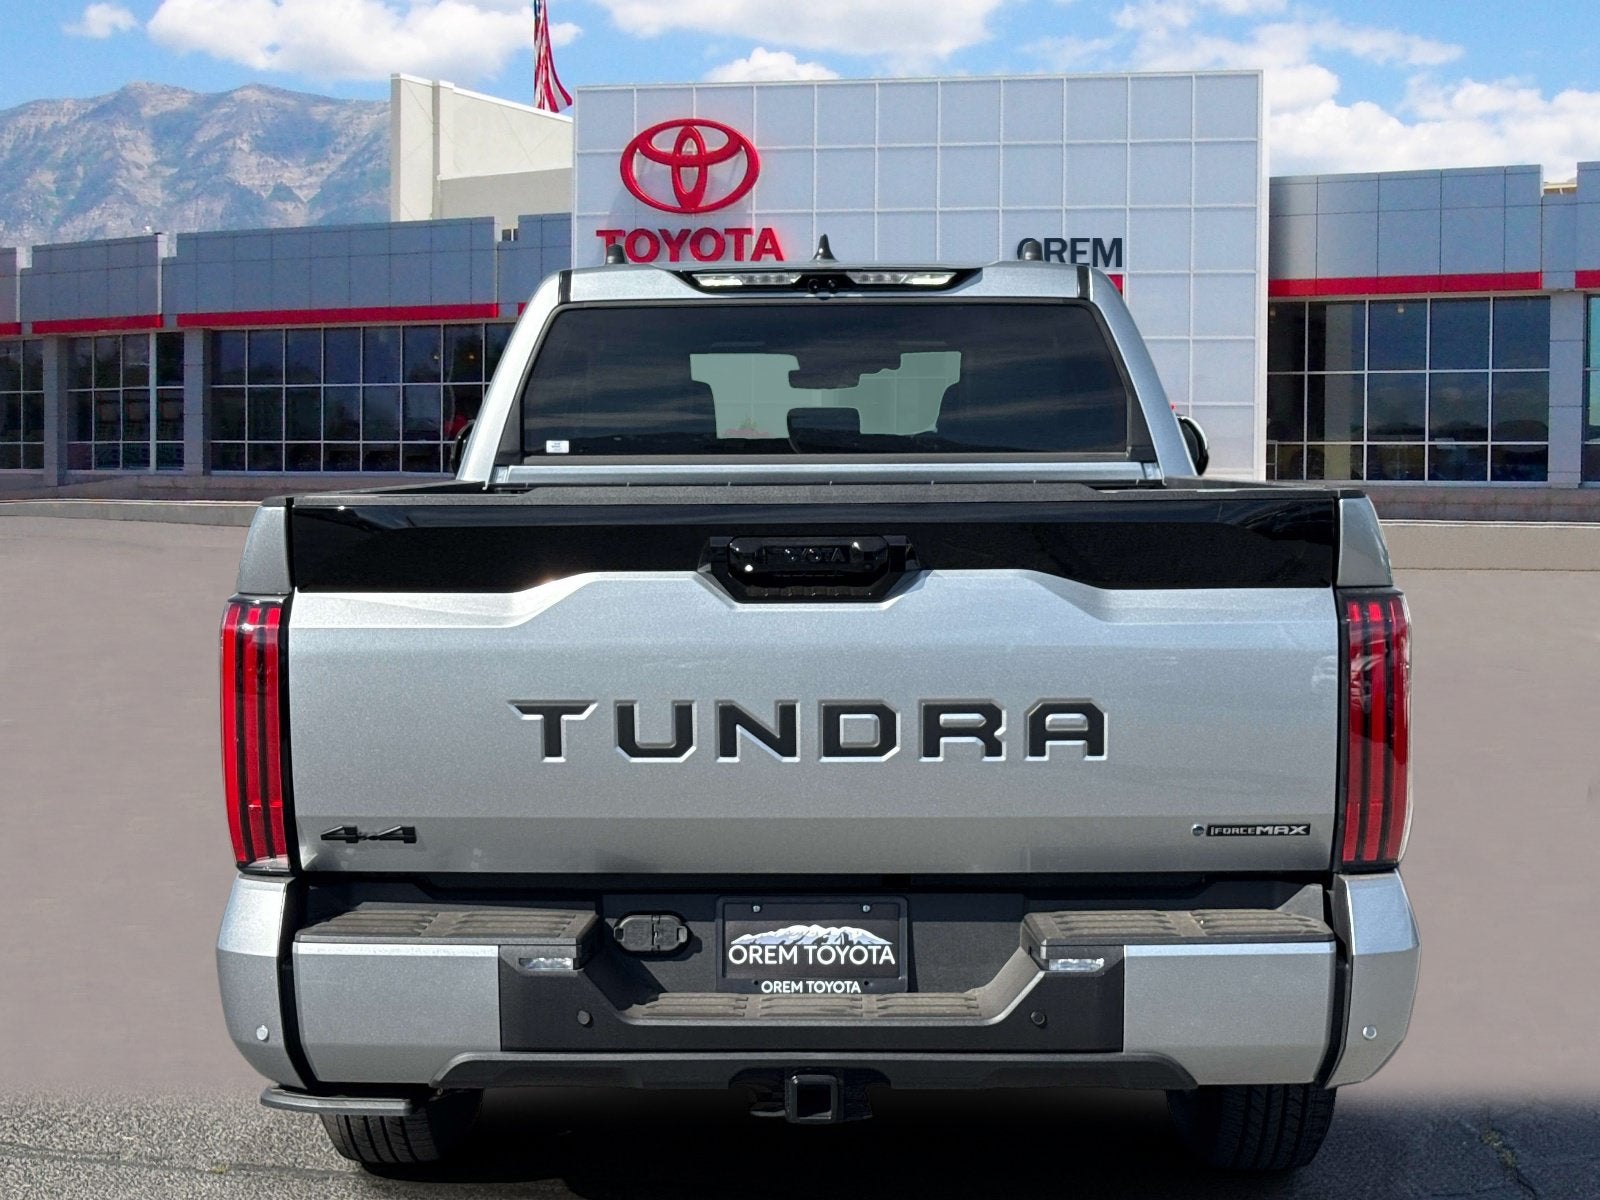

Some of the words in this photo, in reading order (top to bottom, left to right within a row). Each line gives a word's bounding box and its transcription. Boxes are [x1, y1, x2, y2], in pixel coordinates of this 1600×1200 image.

[596, 227, 785, 263] TOYOTA
[507, 698, 1109, 763] TUNDRA
[728, 945, 798, 965] OREM
[803, 945, 896, 965] TOYOTA
[761, 980, 804, 994] OREM
[806, 980, 862, 994] TOYOTA
